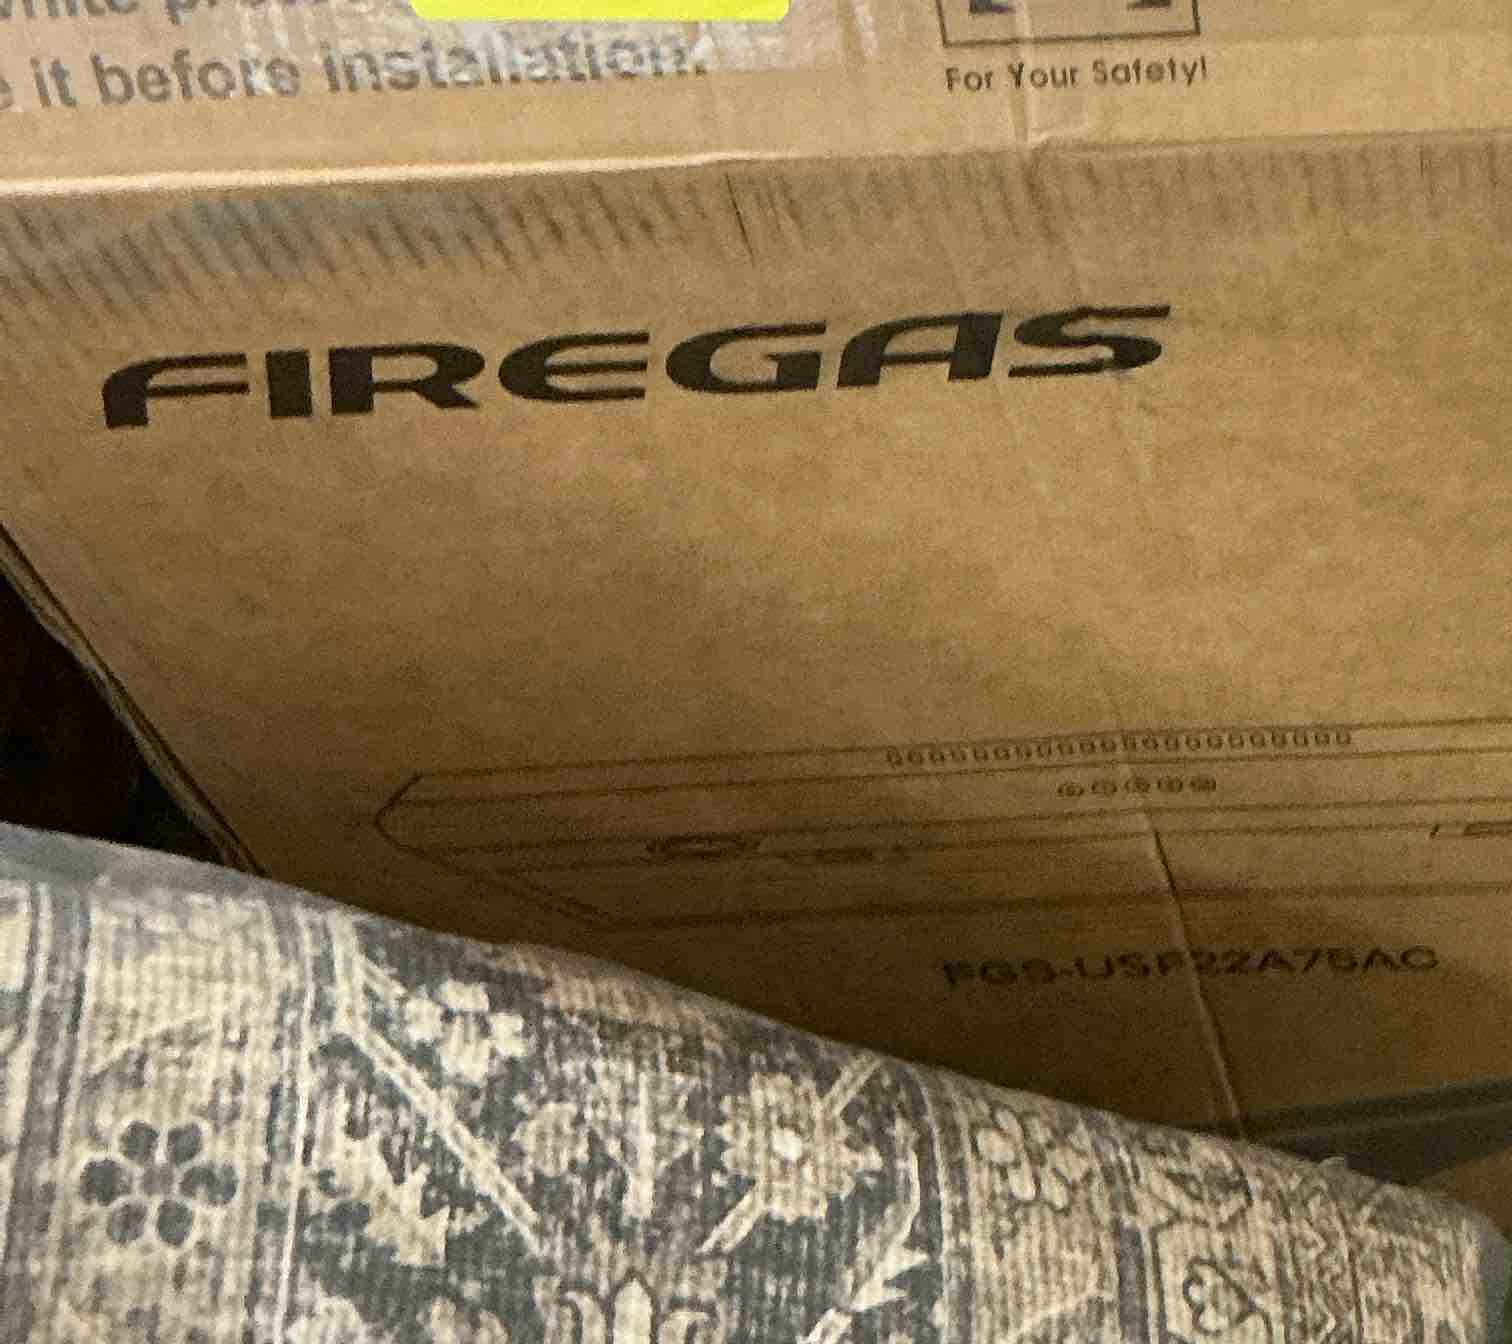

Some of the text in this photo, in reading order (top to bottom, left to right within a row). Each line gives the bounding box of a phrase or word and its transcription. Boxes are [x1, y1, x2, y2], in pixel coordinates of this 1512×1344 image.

[30, 57, 77, 108] it
[89, 49, 301, 106] before
[319, 32, 710, 96] installation.
[945, 55, 1208, 93] For Your Safety!
[100, 304, 1171, 431] FIREGAS
